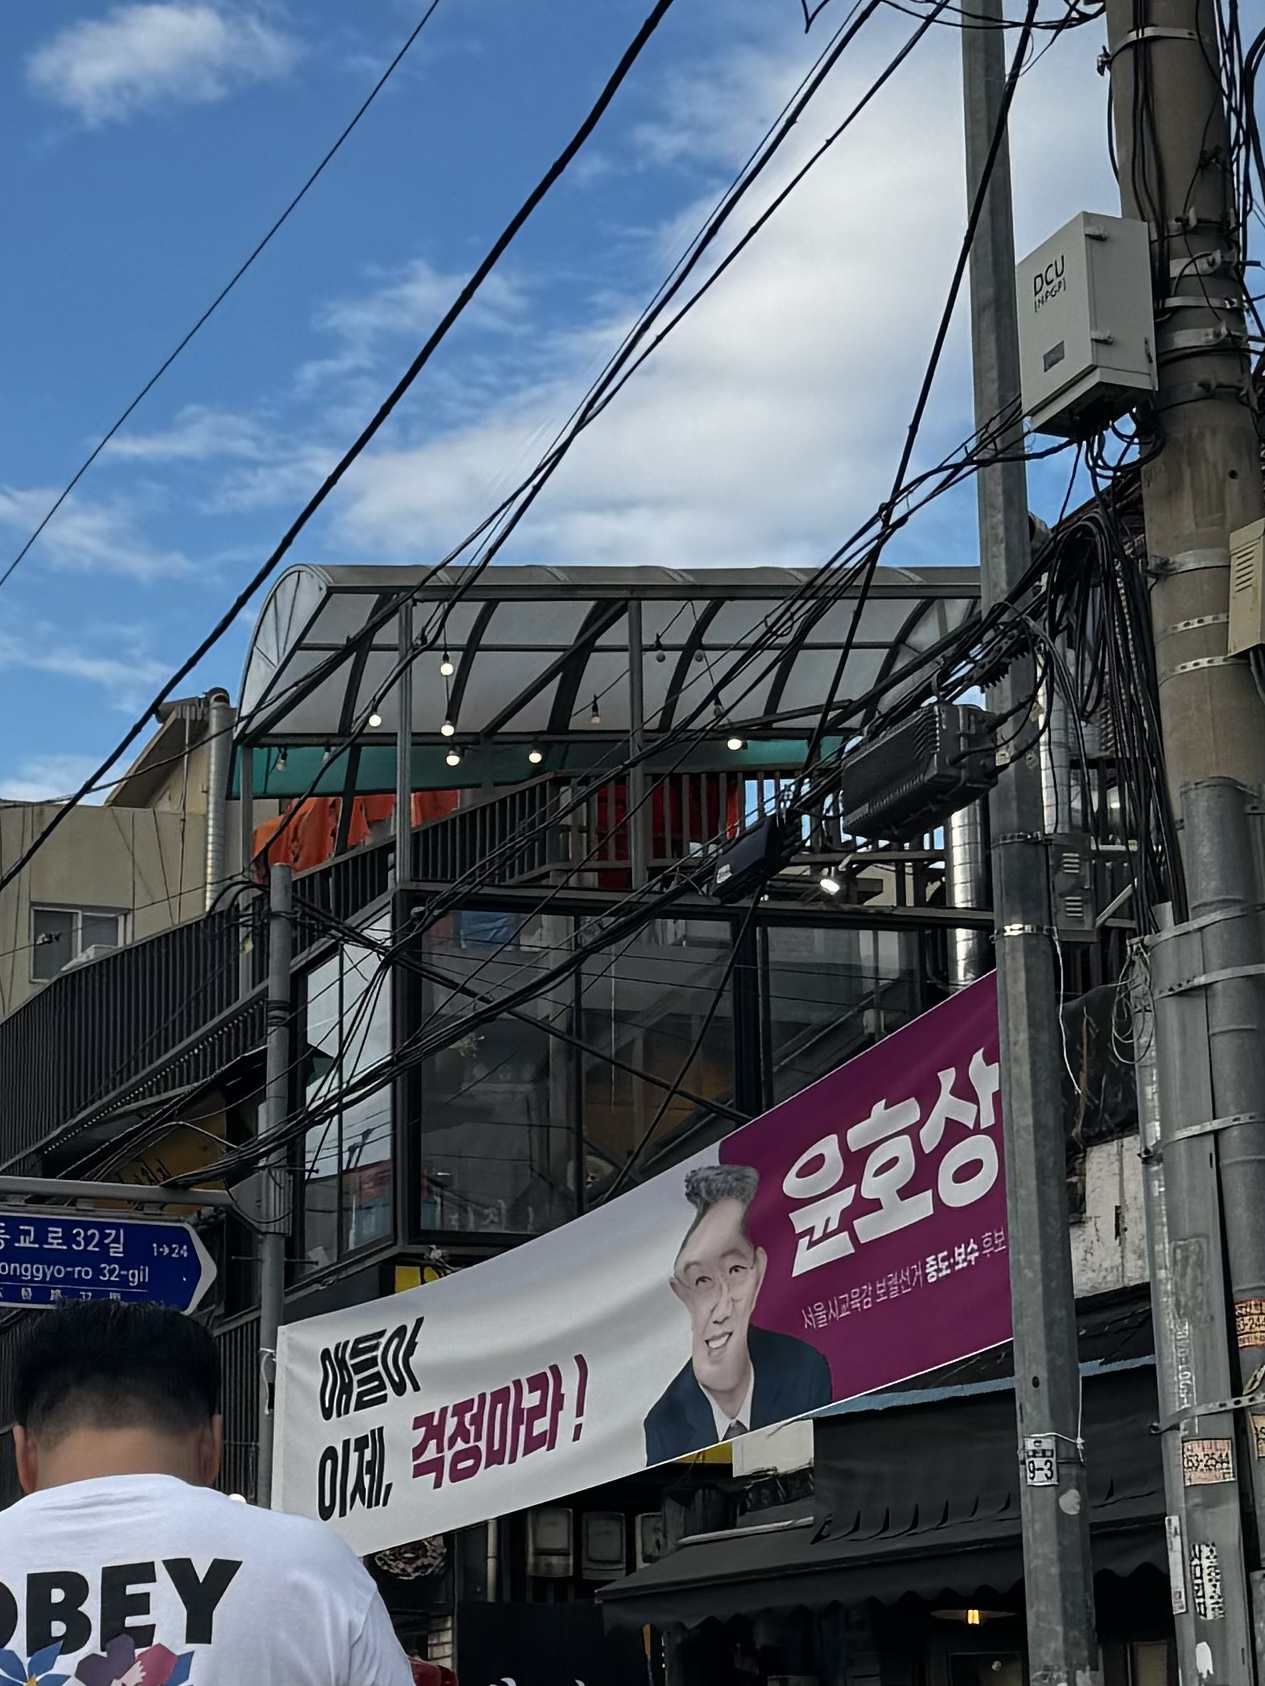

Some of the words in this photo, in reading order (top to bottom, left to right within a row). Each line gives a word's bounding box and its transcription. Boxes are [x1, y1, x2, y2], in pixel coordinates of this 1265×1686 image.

[1034, 255, 1065, 297] DCU
[782, 1046, 1000, 1277] 윤호상
[99, 1264, 149, 1286] 32-gil
[801, 1283, 872, 1329] 서울시교육감
[875, 1260, 923, 1303] 보궐선거
[981, 1226, 1007, 1257] 후보
[1028, 1459, 1054, 1481] 9-3
